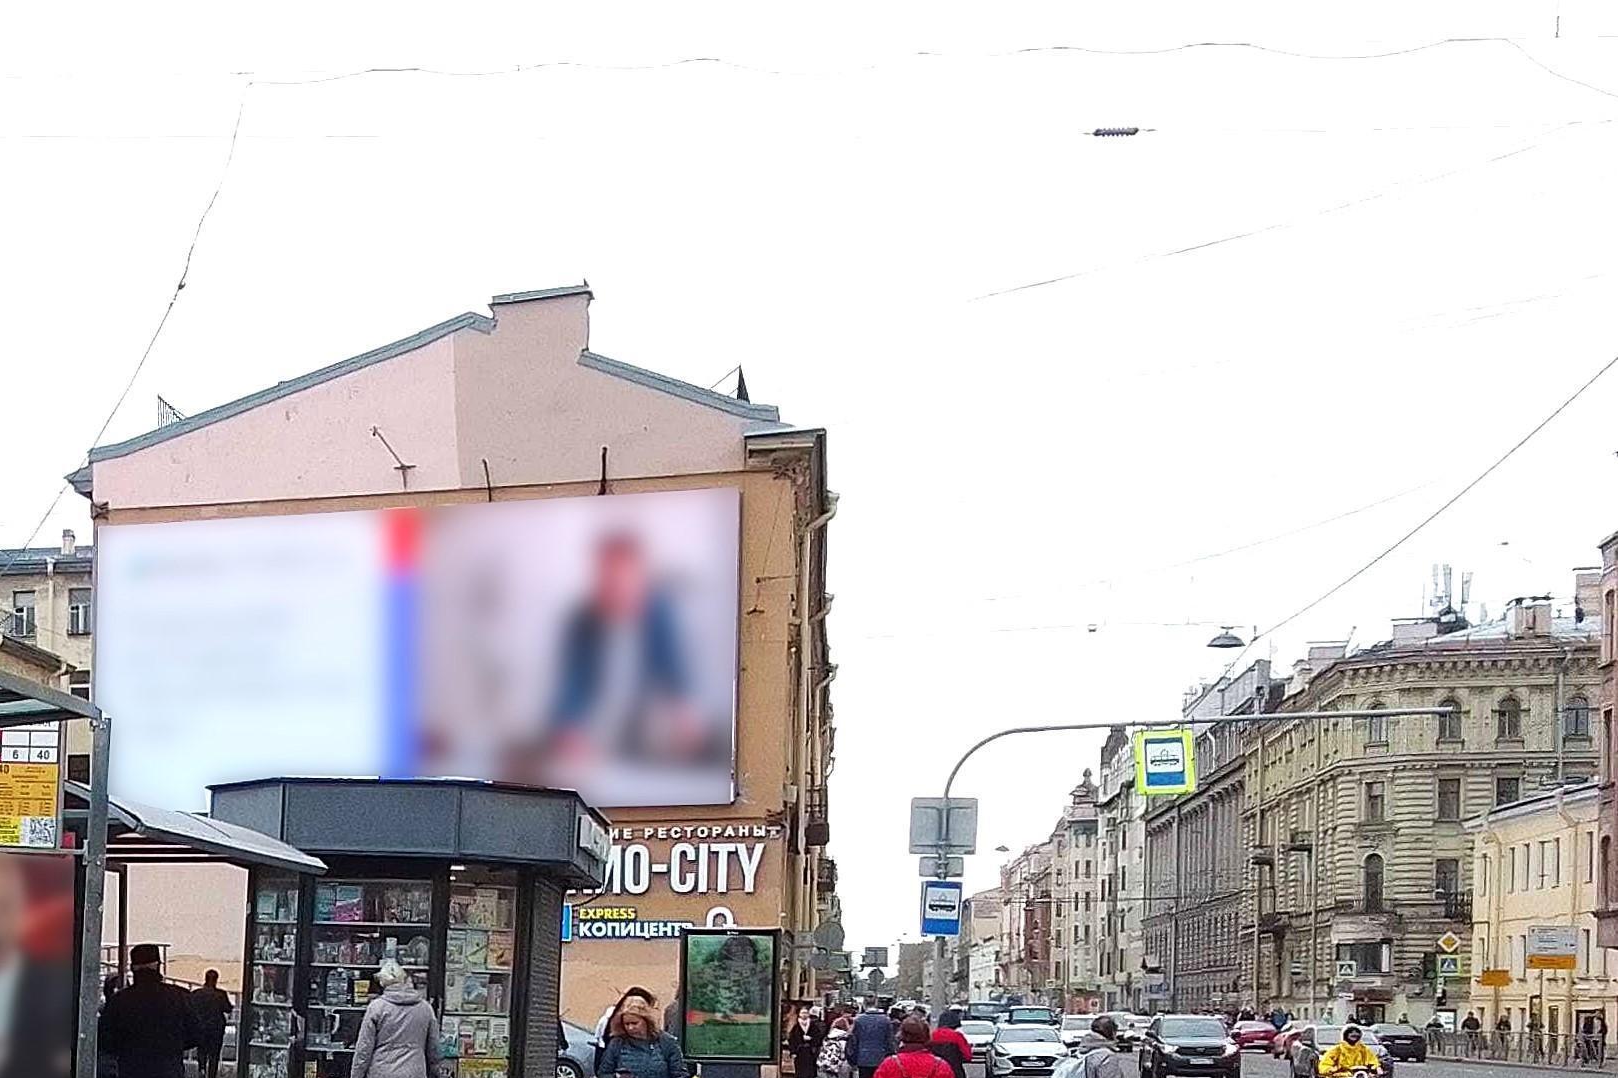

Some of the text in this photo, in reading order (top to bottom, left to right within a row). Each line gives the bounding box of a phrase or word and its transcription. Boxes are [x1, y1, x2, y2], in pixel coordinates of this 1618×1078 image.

[36, 749, 50, 760] 40
[645, 825, 767, 840] РЕСТОРАНЫ
[579, 908, 636, 920] EXPRESS
[579, 922, 693, 939] КОПИЦЕНТ
